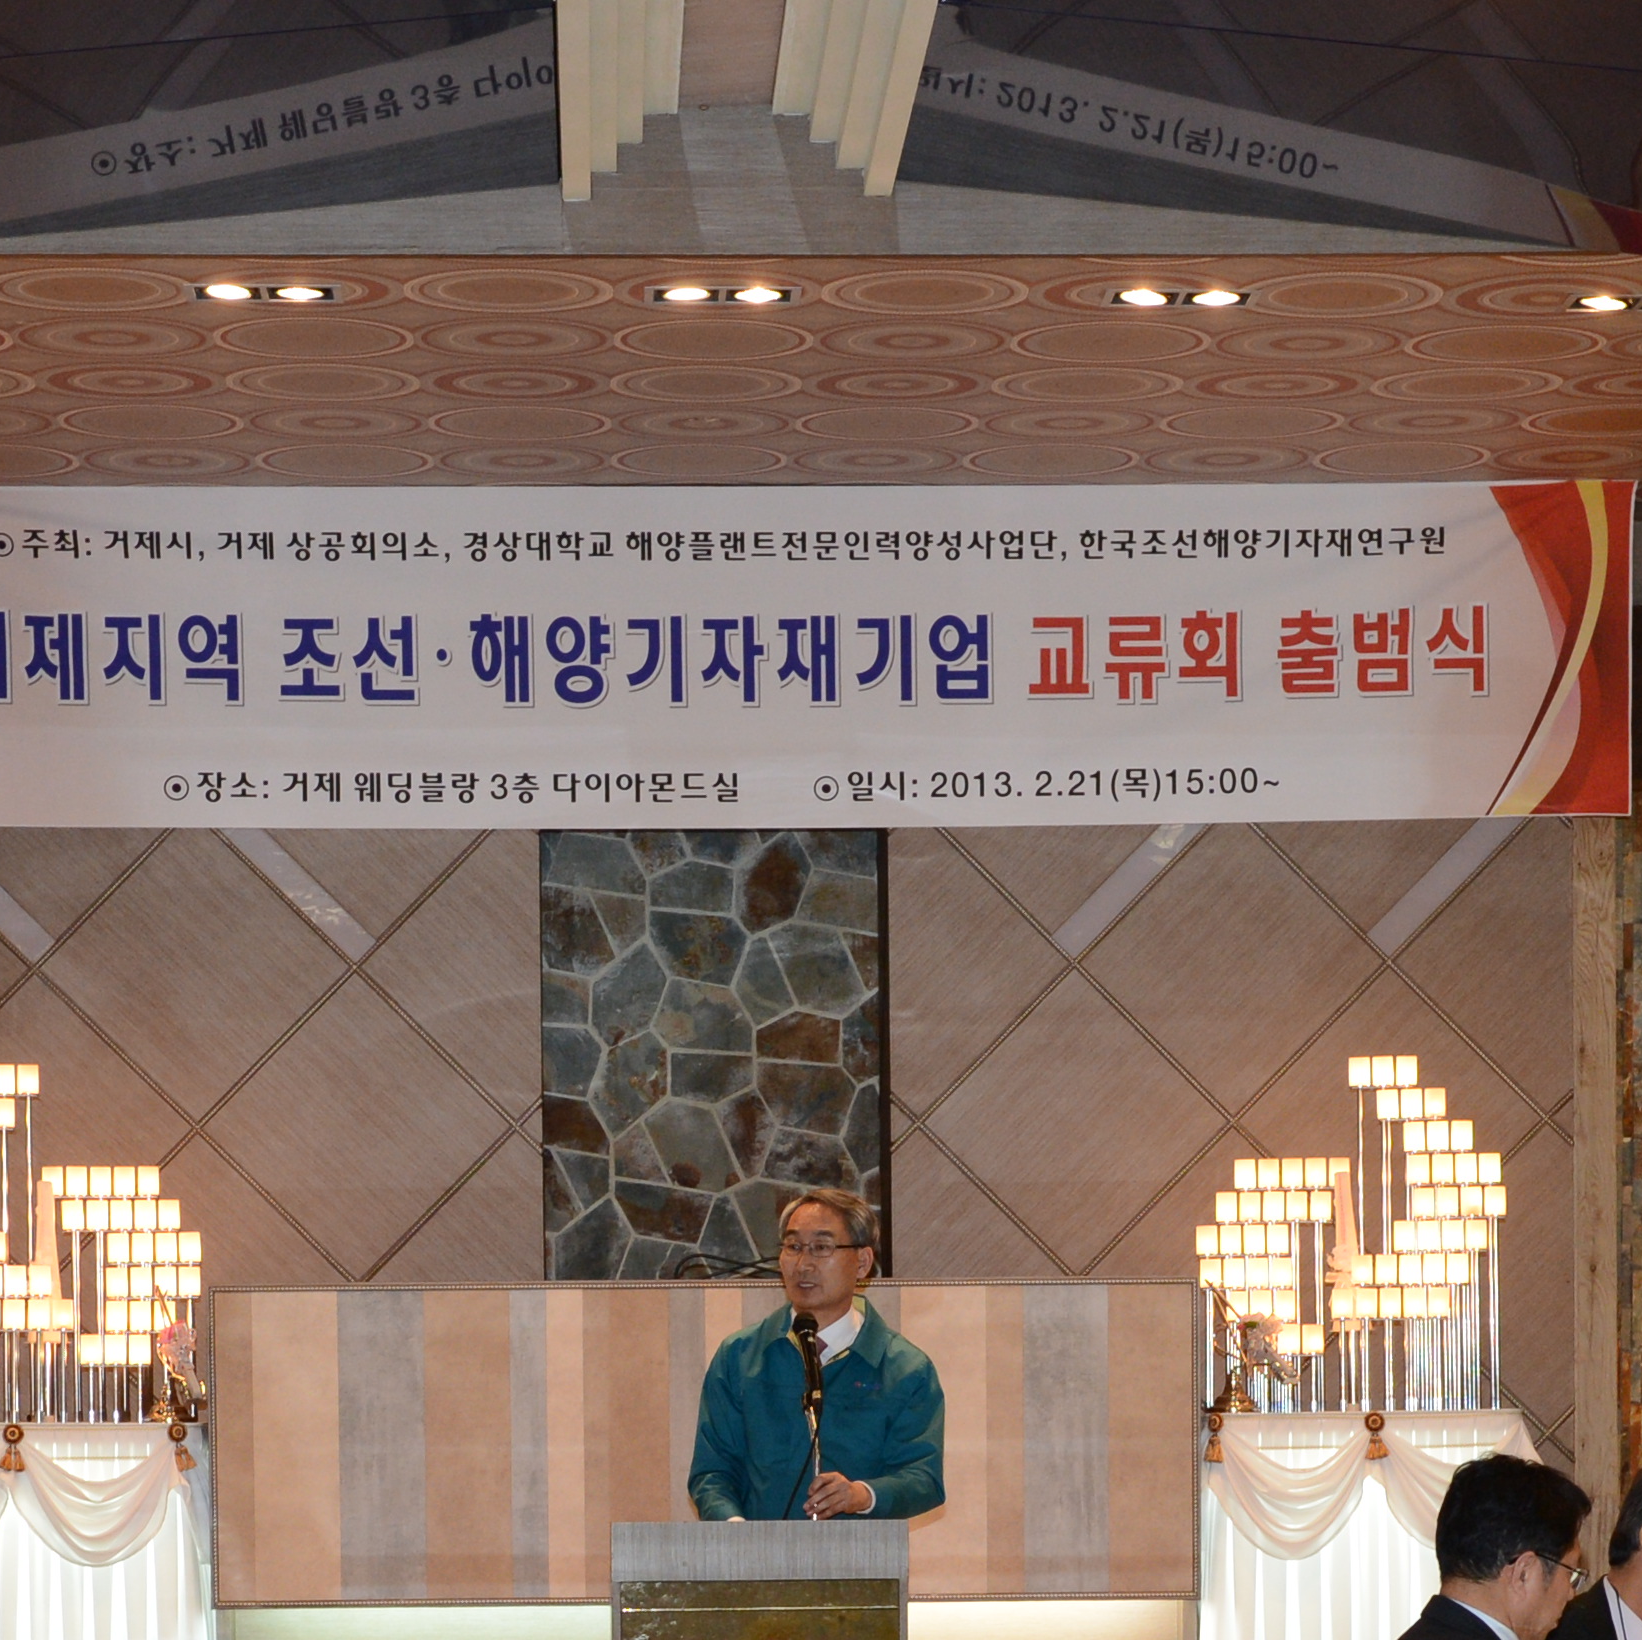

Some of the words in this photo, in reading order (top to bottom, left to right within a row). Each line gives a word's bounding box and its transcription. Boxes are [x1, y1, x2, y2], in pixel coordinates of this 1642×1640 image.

[22, 529, 91, 559] 주최:
[104, 531, 204, 561] 거제시,
[218, 532, 274, 560] 거제
[287, 532, 450, 563] 상공회의소,
[464, 532, 613, 562] 경상대학교
[626, 531, 1066, 561] 해양플랜트전문인력양성사업단,
[1080, 527, 1444, 559] 한국조선해양기자재연구원
[1029, 611, 1237, 699] 교류회
[1278, 606, 1489, 697] 출범식
[197, 772, 268, 802] 장소:
[284, 773, 340, 802] 거제
[355, 773, 479, 803] 웨딩블랑
[491, 773, 539, 803] 3층
[554, 773, 738, 802] 다이아몬드실
[848, 772, 917, 801] 일시:
[931, 772, 1022, 797] 2013.
[1036, 768, 1279, 801] 2.21(목)15:00~
